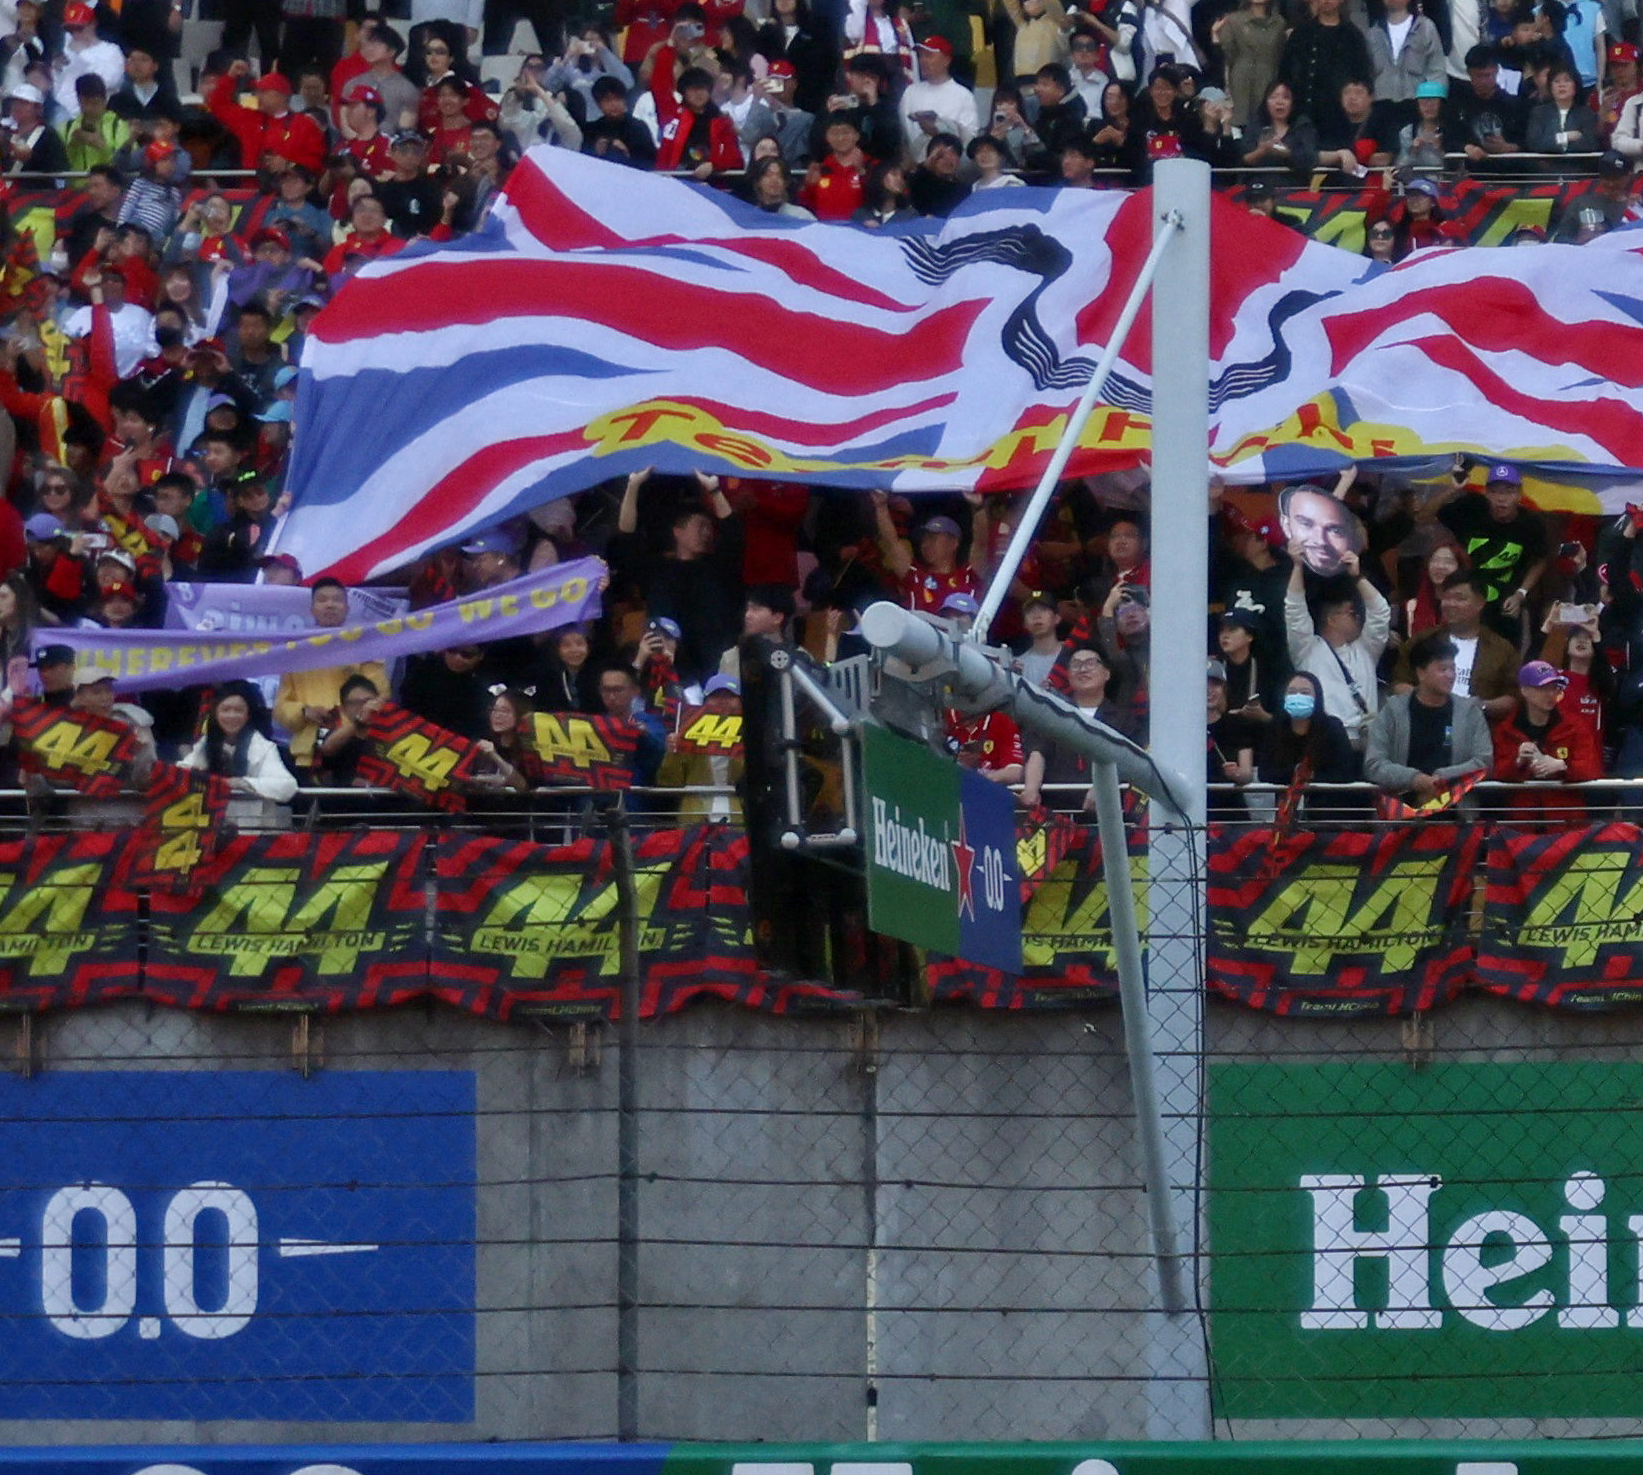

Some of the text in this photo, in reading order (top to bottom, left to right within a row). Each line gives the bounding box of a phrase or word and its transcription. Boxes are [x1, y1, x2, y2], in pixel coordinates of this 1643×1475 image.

[459, 590, 519, 624] WE
[531, 576, 590, 610] GO
[34, 721, 122, 776] 44
[532, 711, 612, 768] 44
[685, 713, 744, 750] 44
[385, 731, 463, 793] 44
[872, 796, 950, 892] Heineken
[983, 844, 1004, 912] 0.0
[187, 860, 390, 977] 44
[197, 931, 376, 954] LEWIS HAMILTON
[470, 860, 671, 979] 44
[478, 933, 657, 954] LEWIS HAMILN
[1245, 855, 1449, 976] 44
[1252, 931, 1437, 952] LEWIS HAMILTON
[1526, 926, 1593, 944] LEWIS
[41, 1180, 258, 1339] 0.0
